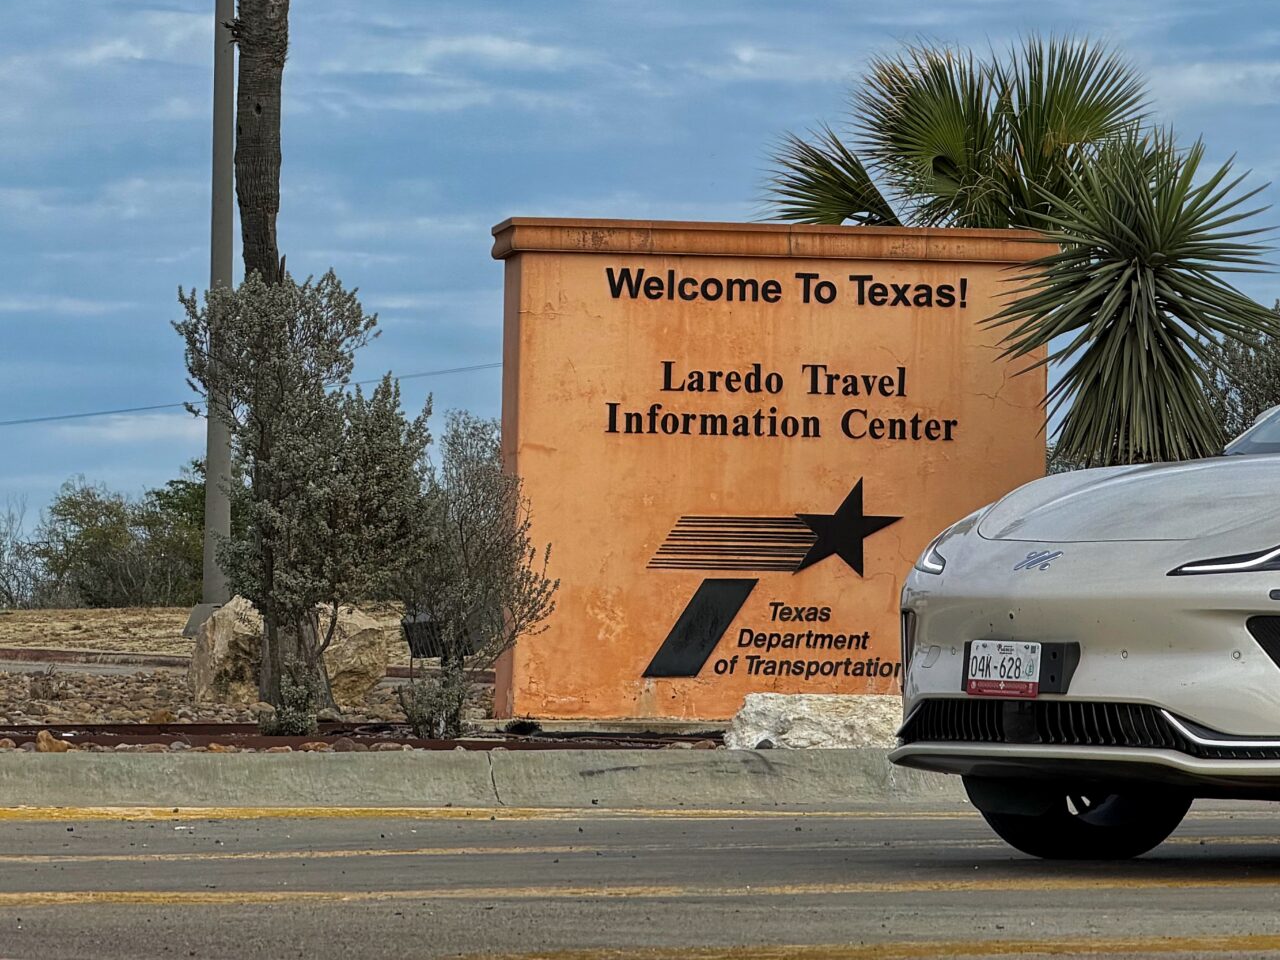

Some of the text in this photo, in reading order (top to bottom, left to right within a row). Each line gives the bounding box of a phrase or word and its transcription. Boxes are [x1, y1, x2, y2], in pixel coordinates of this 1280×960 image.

[605, 267, 968, 309] Welcome To Texas!
[660, 360, 907, 398] Laredo Travel
[604, 402, 958, 442] Information Center
[769, 601, 832, 623] Texas
[737, 628, 870, 652] Department
[714, 655, 739, 675] of
